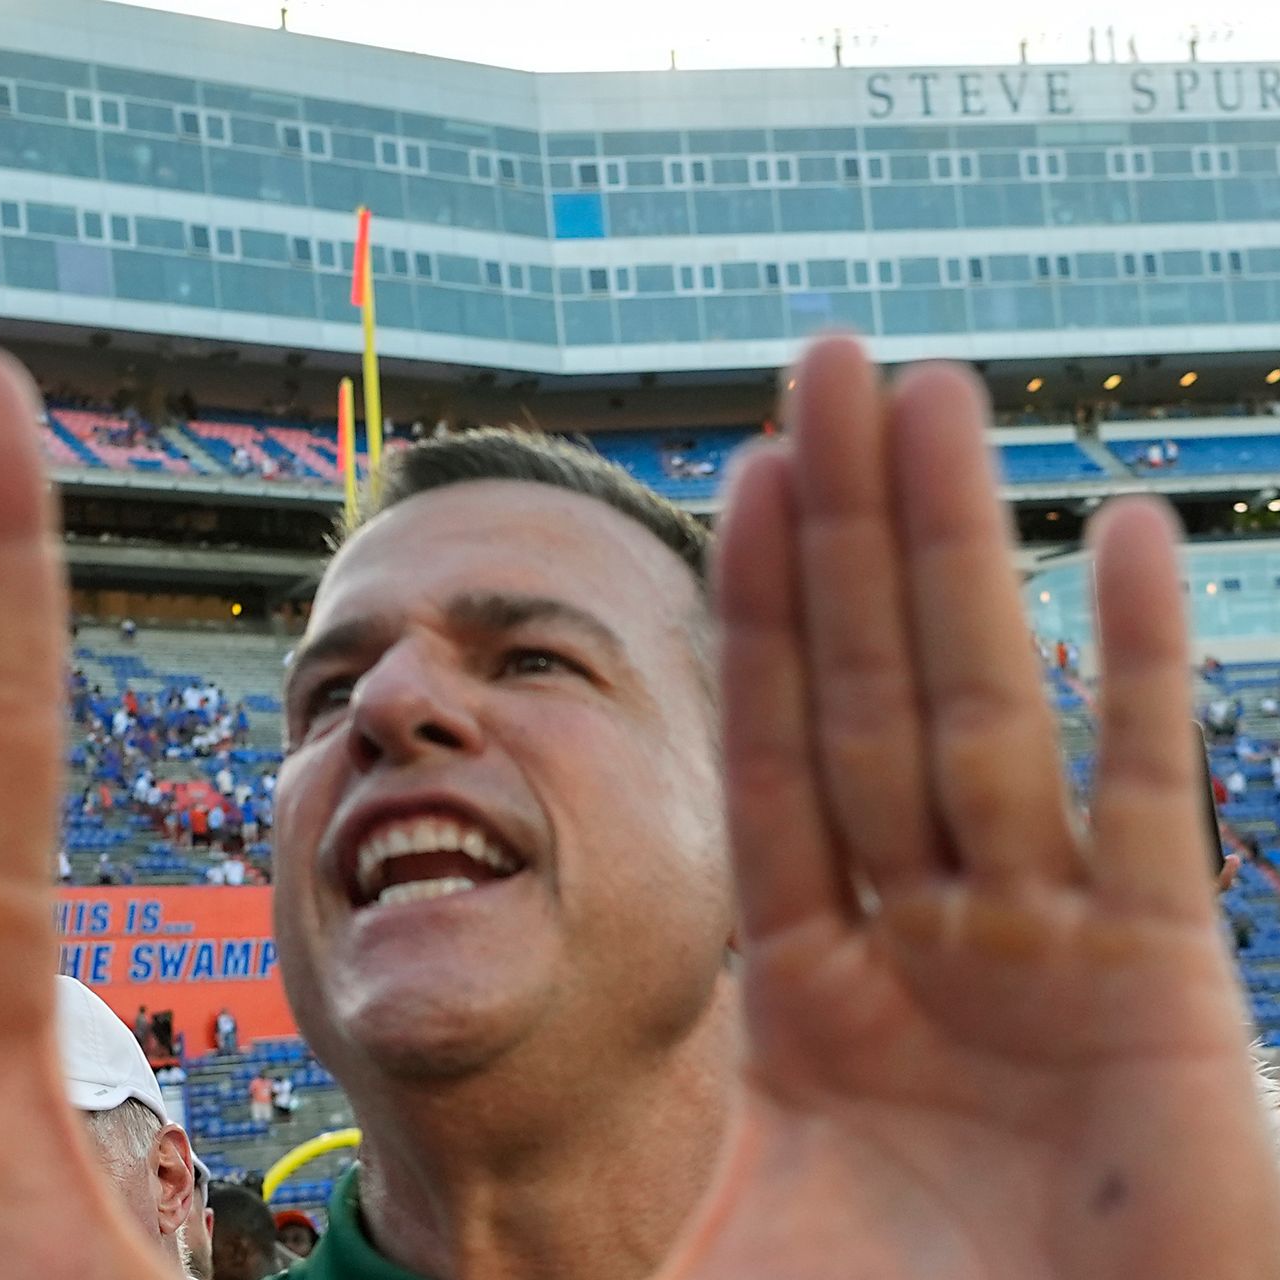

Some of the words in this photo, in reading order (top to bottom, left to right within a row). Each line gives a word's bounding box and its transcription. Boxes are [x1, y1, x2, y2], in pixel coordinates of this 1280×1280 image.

[867, 71, 1075, 120] STEVE
[55, 901, 110, 932] HIS
[60, 942, 113, 982] HE
[130, 940, 278, 980] SWAMP
